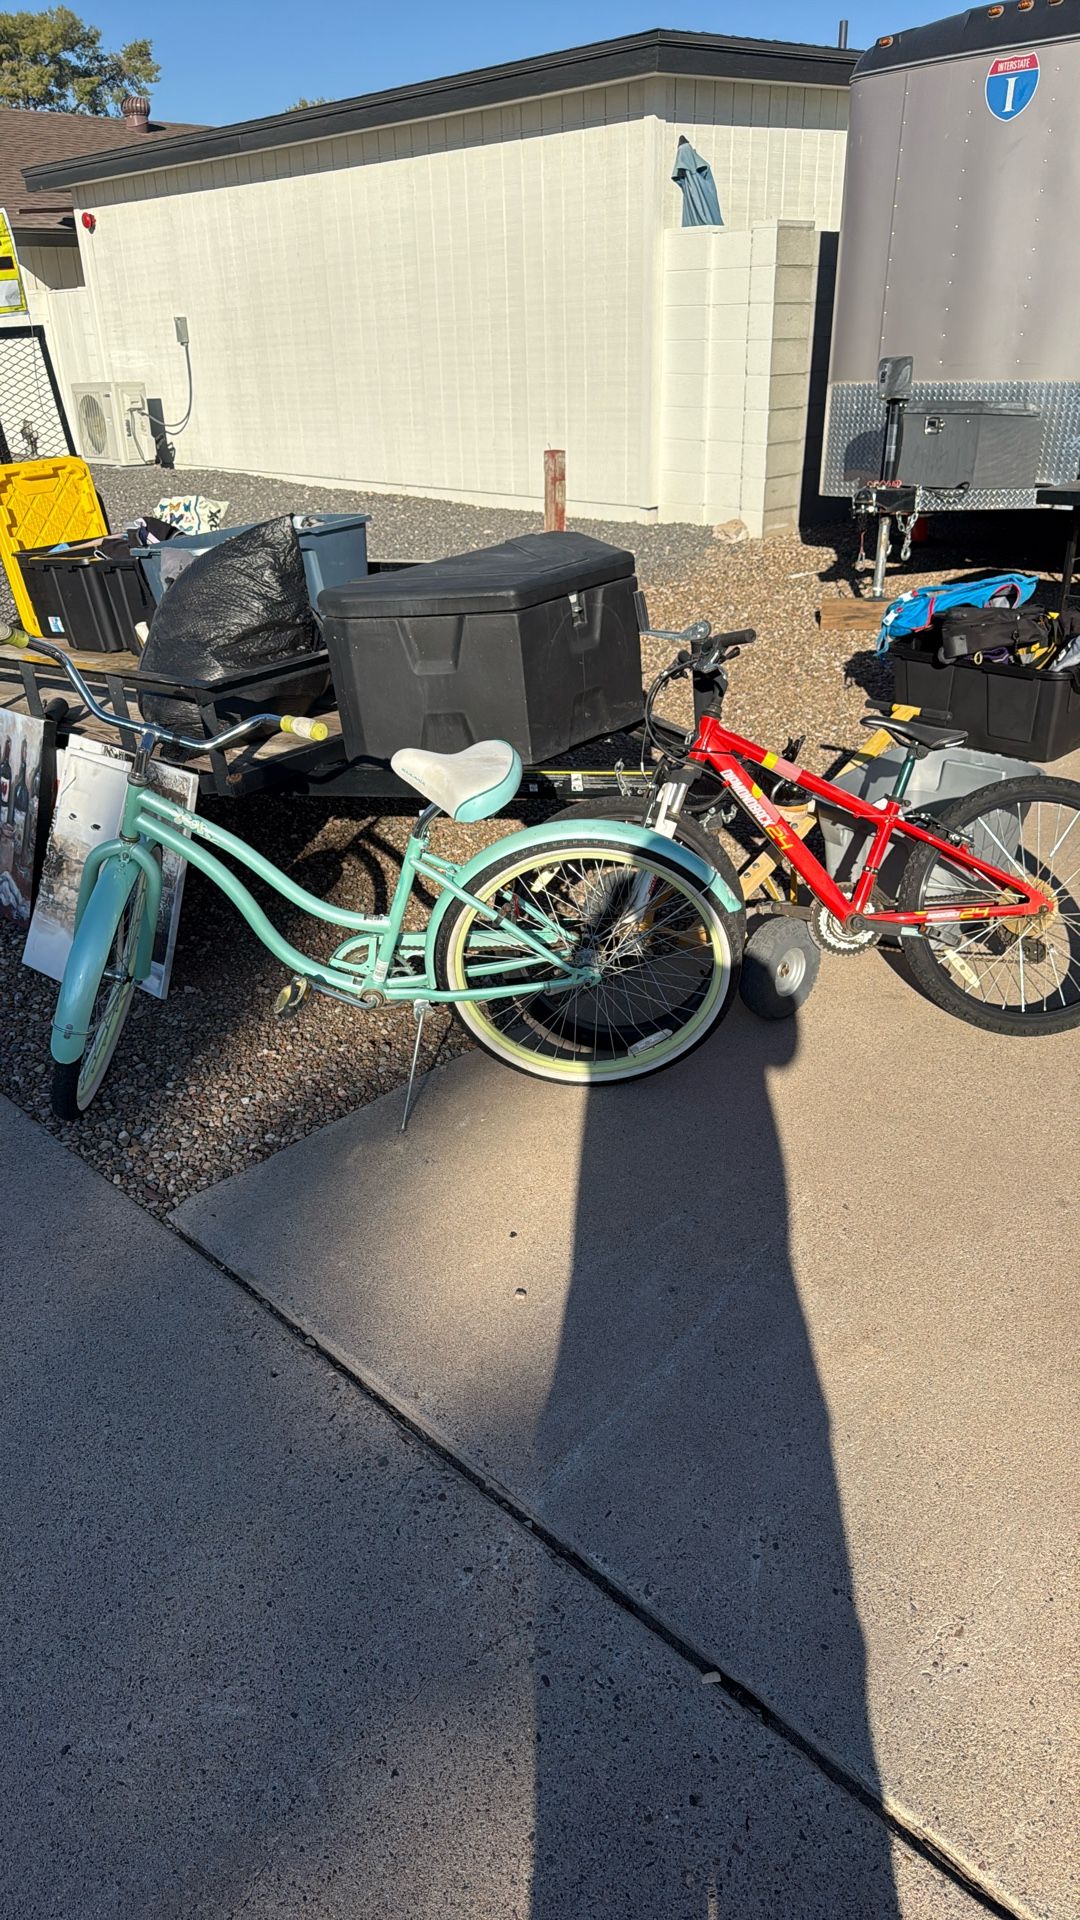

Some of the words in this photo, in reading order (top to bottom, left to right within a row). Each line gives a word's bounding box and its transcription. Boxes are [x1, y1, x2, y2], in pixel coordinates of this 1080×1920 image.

[997, 58, 1031, 72] INTERSTATE
[1001, 76, 1019, 113] I
[720, 768, 776, 828] DIAMONDBACK
[765, 825, 795, 850] 24
[960, 907, 999, 919] 24
